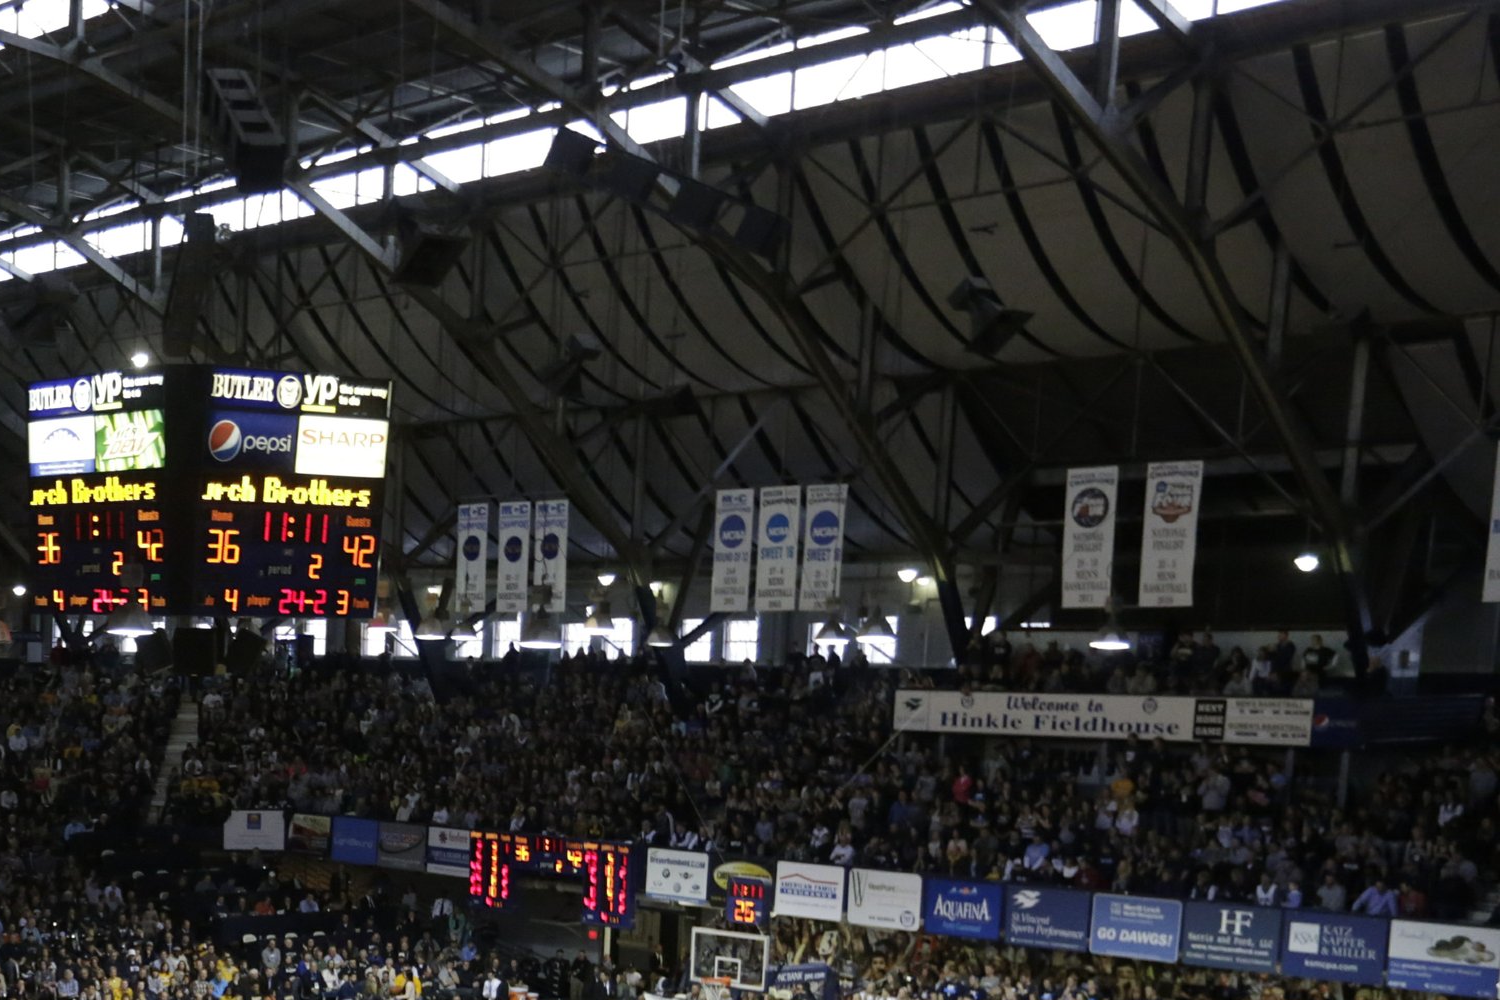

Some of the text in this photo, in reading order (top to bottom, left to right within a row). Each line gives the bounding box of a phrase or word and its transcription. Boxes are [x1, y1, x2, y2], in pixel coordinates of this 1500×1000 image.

[28, 385, 73, 411] BUTLER
[211, 374, 275, 402] BUTLER
[304, 374, 338, 405] yp
[242, 434, 292, 454] pepsi
[302, 429, 385, 448] SHARP
[71, 476, 155, 504] Brothers
[263, 476, 371, 507] Brothers
[263, 511, 329, 544] 11:11
[37, 532, 60, 564] 36
[137, 529, 163, 562] 42
[206, 529, 240, 564] 36
[343, 535, 376, 568] 42
[113, 551, 123, 575] 2
[308, 554, 323, 580] 2
[53, 589, 64, 611] 4
[224, 588, 238, 612] 4
[336, 589, 349, 616] 3
[1006, 695, 1103, 713] Welcome to
[940, 711, 1023, 731] Hinkle
[1033, 714, 1180, 737] Fieldhouse
[780, 881, 837, 894] AMERICAN FAMILY
[933, 893, 991, 922] AQUAFINA
[1141, 904, 1160, 913] Lynch
[1011, 923, 1084, 940] Sports Performance
[1218, 909, 1254, 936] HF
[1322, 925, 1353, 936] KATZ
[1097, 926, 1172, 947] GO DAWGS!
[1322, 935, 1366, 948] SAPPER
[1304, 959, 1358, 972] ksmcpa.com
[1320, 946, 1376, 960] & MILLER
